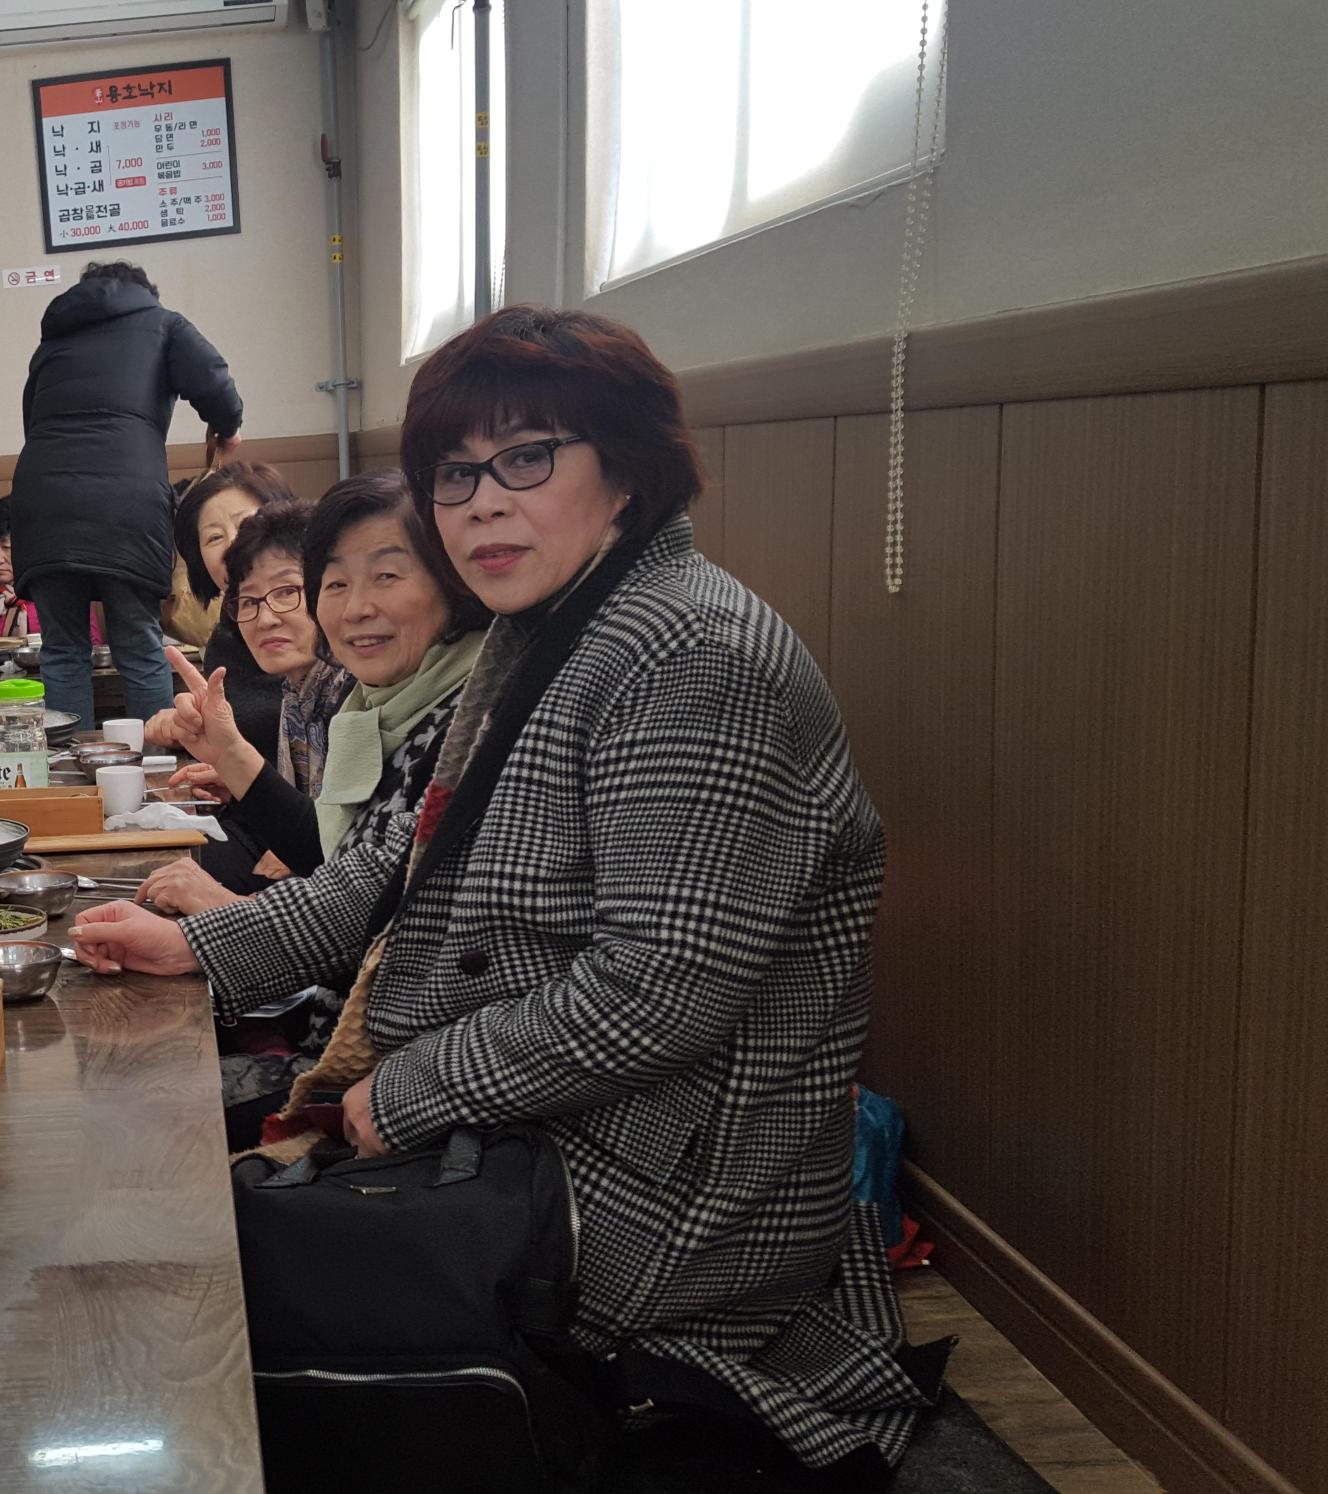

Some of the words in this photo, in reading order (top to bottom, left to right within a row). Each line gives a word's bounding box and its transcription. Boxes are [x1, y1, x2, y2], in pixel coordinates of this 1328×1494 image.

[106, 79, 173, 103] 용호낙지
[154, 112, 173, 122] 사리
[116, 157, 143, 170] 7,000
[157, 159, 181, 170] 어린이
[70, 225, 101, 238] 30,000
[118, 220, 149, 232] 40,000
